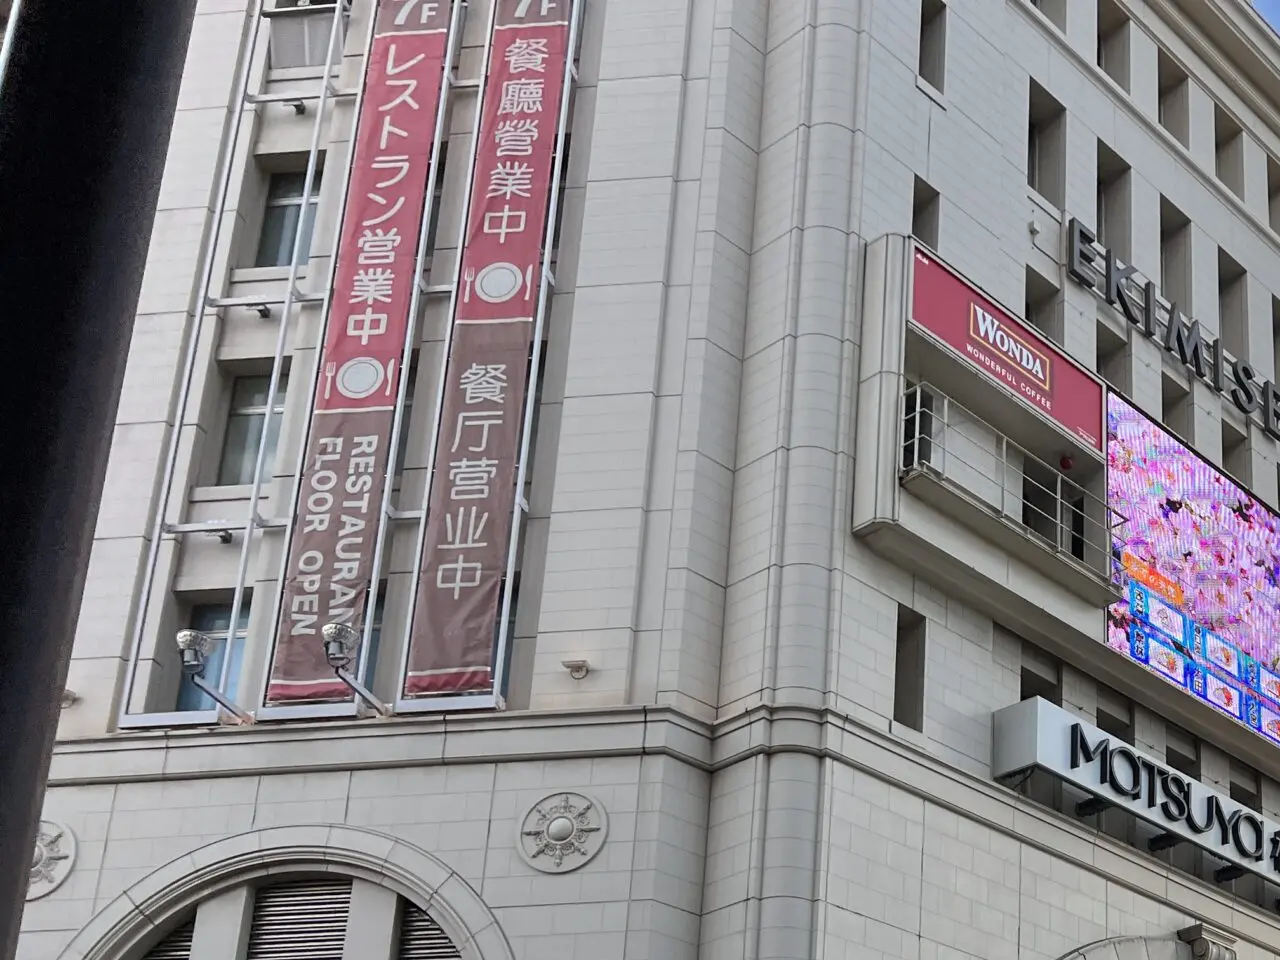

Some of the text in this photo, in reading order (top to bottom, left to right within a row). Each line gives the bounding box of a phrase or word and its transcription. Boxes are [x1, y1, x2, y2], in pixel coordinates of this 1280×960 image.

[347, 44, 426, 345] レストラン営業中
[966, 343, 1052, 410] WONDERFUL COFFEE
[974, 304, 1045, 381] WONDA
[291, 437, 343, 636] FLOOR OPEN
[328, 435, 379, 629] RESTAURAN
[436, 362, 508, 600] 餐厅营业中
